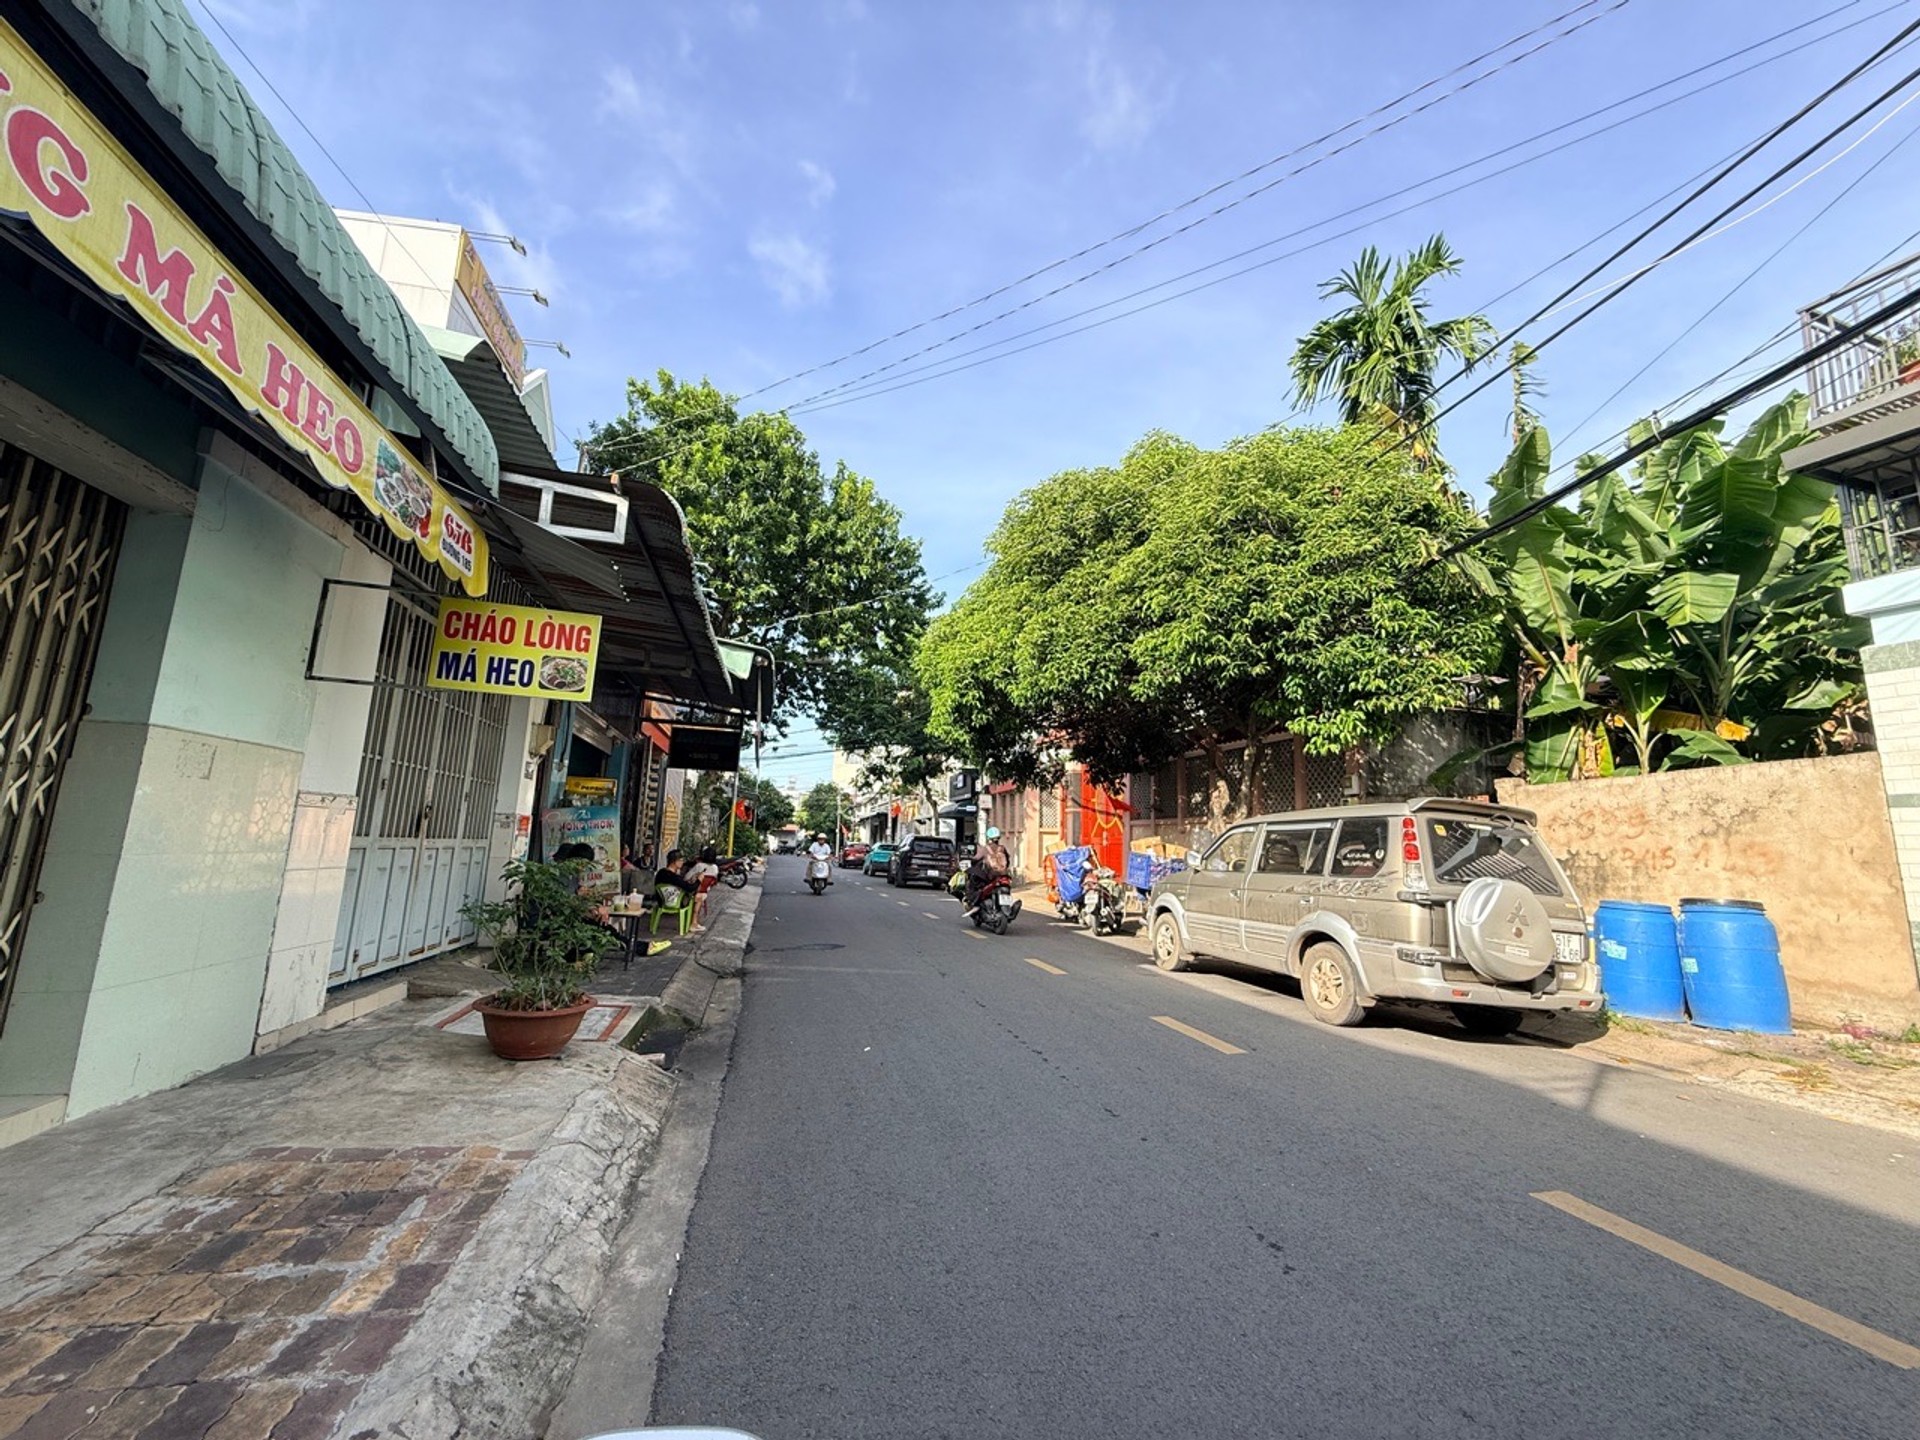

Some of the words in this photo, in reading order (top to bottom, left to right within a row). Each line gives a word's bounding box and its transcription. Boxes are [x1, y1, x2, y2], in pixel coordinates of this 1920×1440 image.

[0, 69, 92, 221] G
[116, 202, 243, 376] MÁ
[260, 342, 365, 475] HEO
[444, 513, 472, 555] 65B
[461, 555, 472, 572] 185
[443, 609, 516, 645] CHÁO
[523, 615, 592, 653] LÒNG
[436, 648, 477, 683] MÁ
[485, 655, 535, 688] HEO
[1555, 934, 1573, 948] 51F
